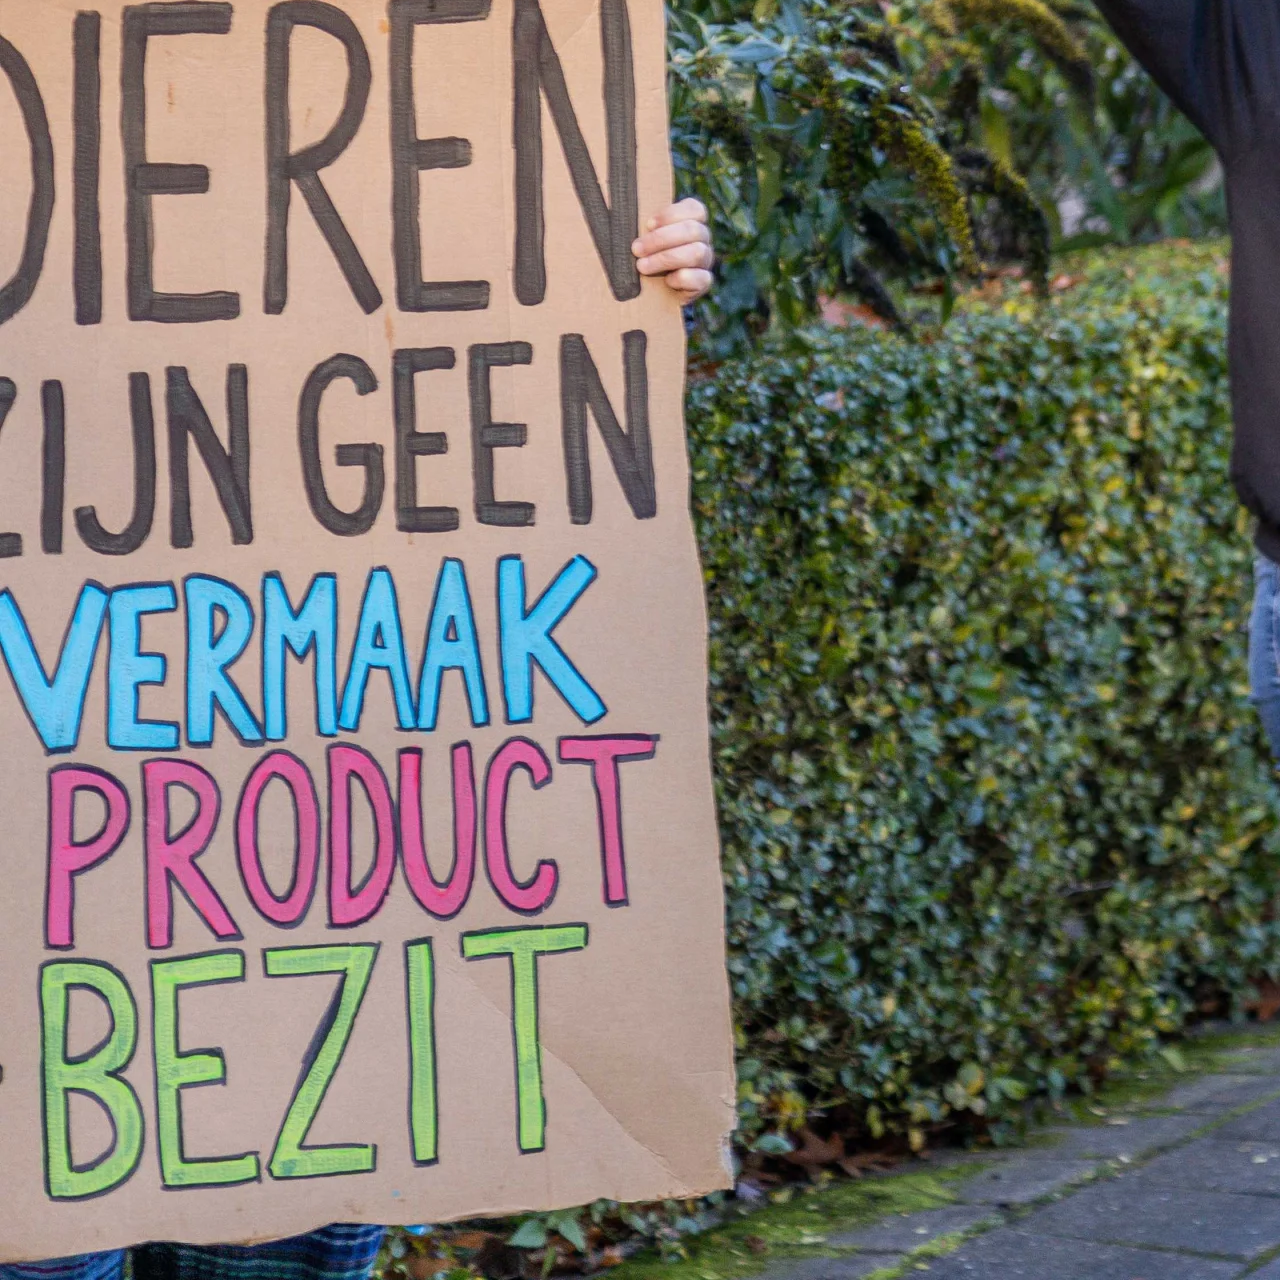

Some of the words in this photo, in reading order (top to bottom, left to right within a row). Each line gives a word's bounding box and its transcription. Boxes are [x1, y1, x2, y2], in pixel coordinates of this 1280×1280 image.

[299, 329, 657, 536] GEEN
[0, 554, 608, 755] VERMAAK
[43, 733, 660, 950] PRODUCT
[39, 923, 590, 1202] BEZIT
